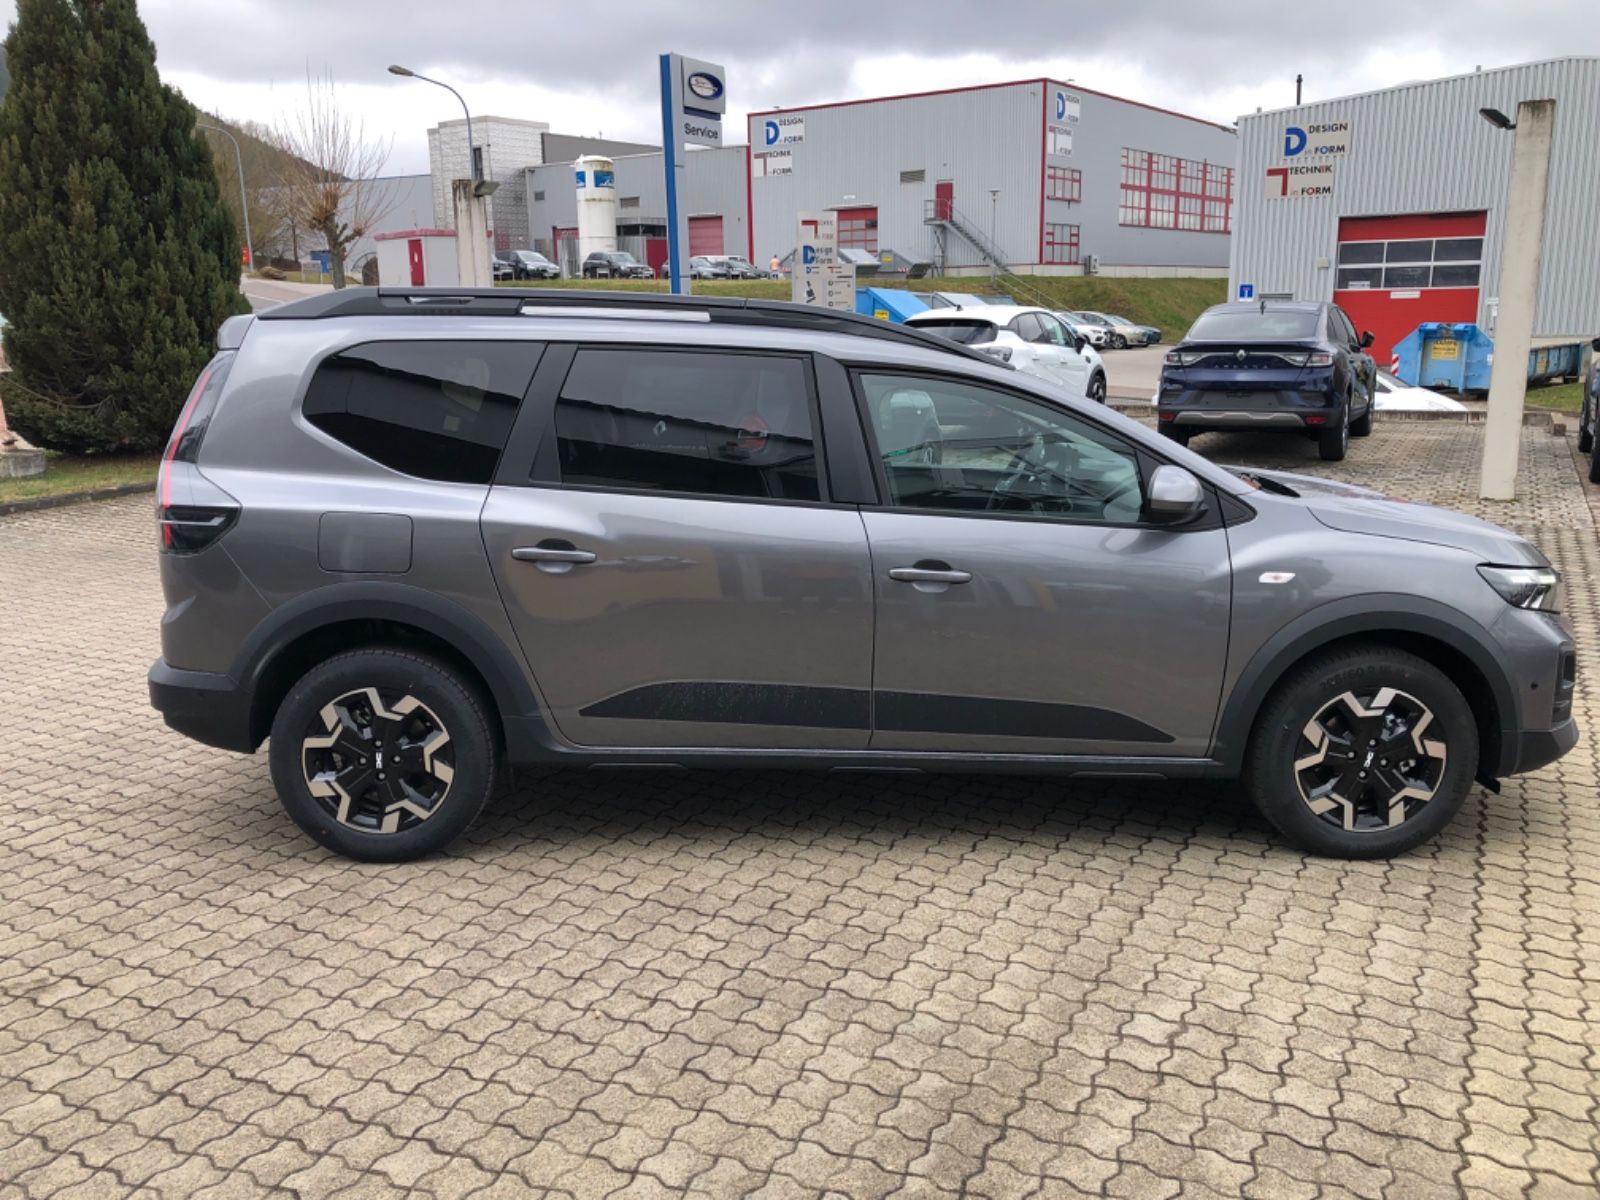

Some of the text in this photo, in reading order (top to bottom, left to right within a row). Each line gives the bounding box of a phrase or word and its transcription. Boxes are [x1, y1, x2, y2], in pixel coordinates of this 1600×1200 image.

[684, 123, 718, 139] Service
[1309, 123, 1348, 133] DESIGN
[1314, 145, 1345, 154] FORM
[1290, 165, 1332, 175] TECHNIK
[1301, 186, 1332, 196] FORM
